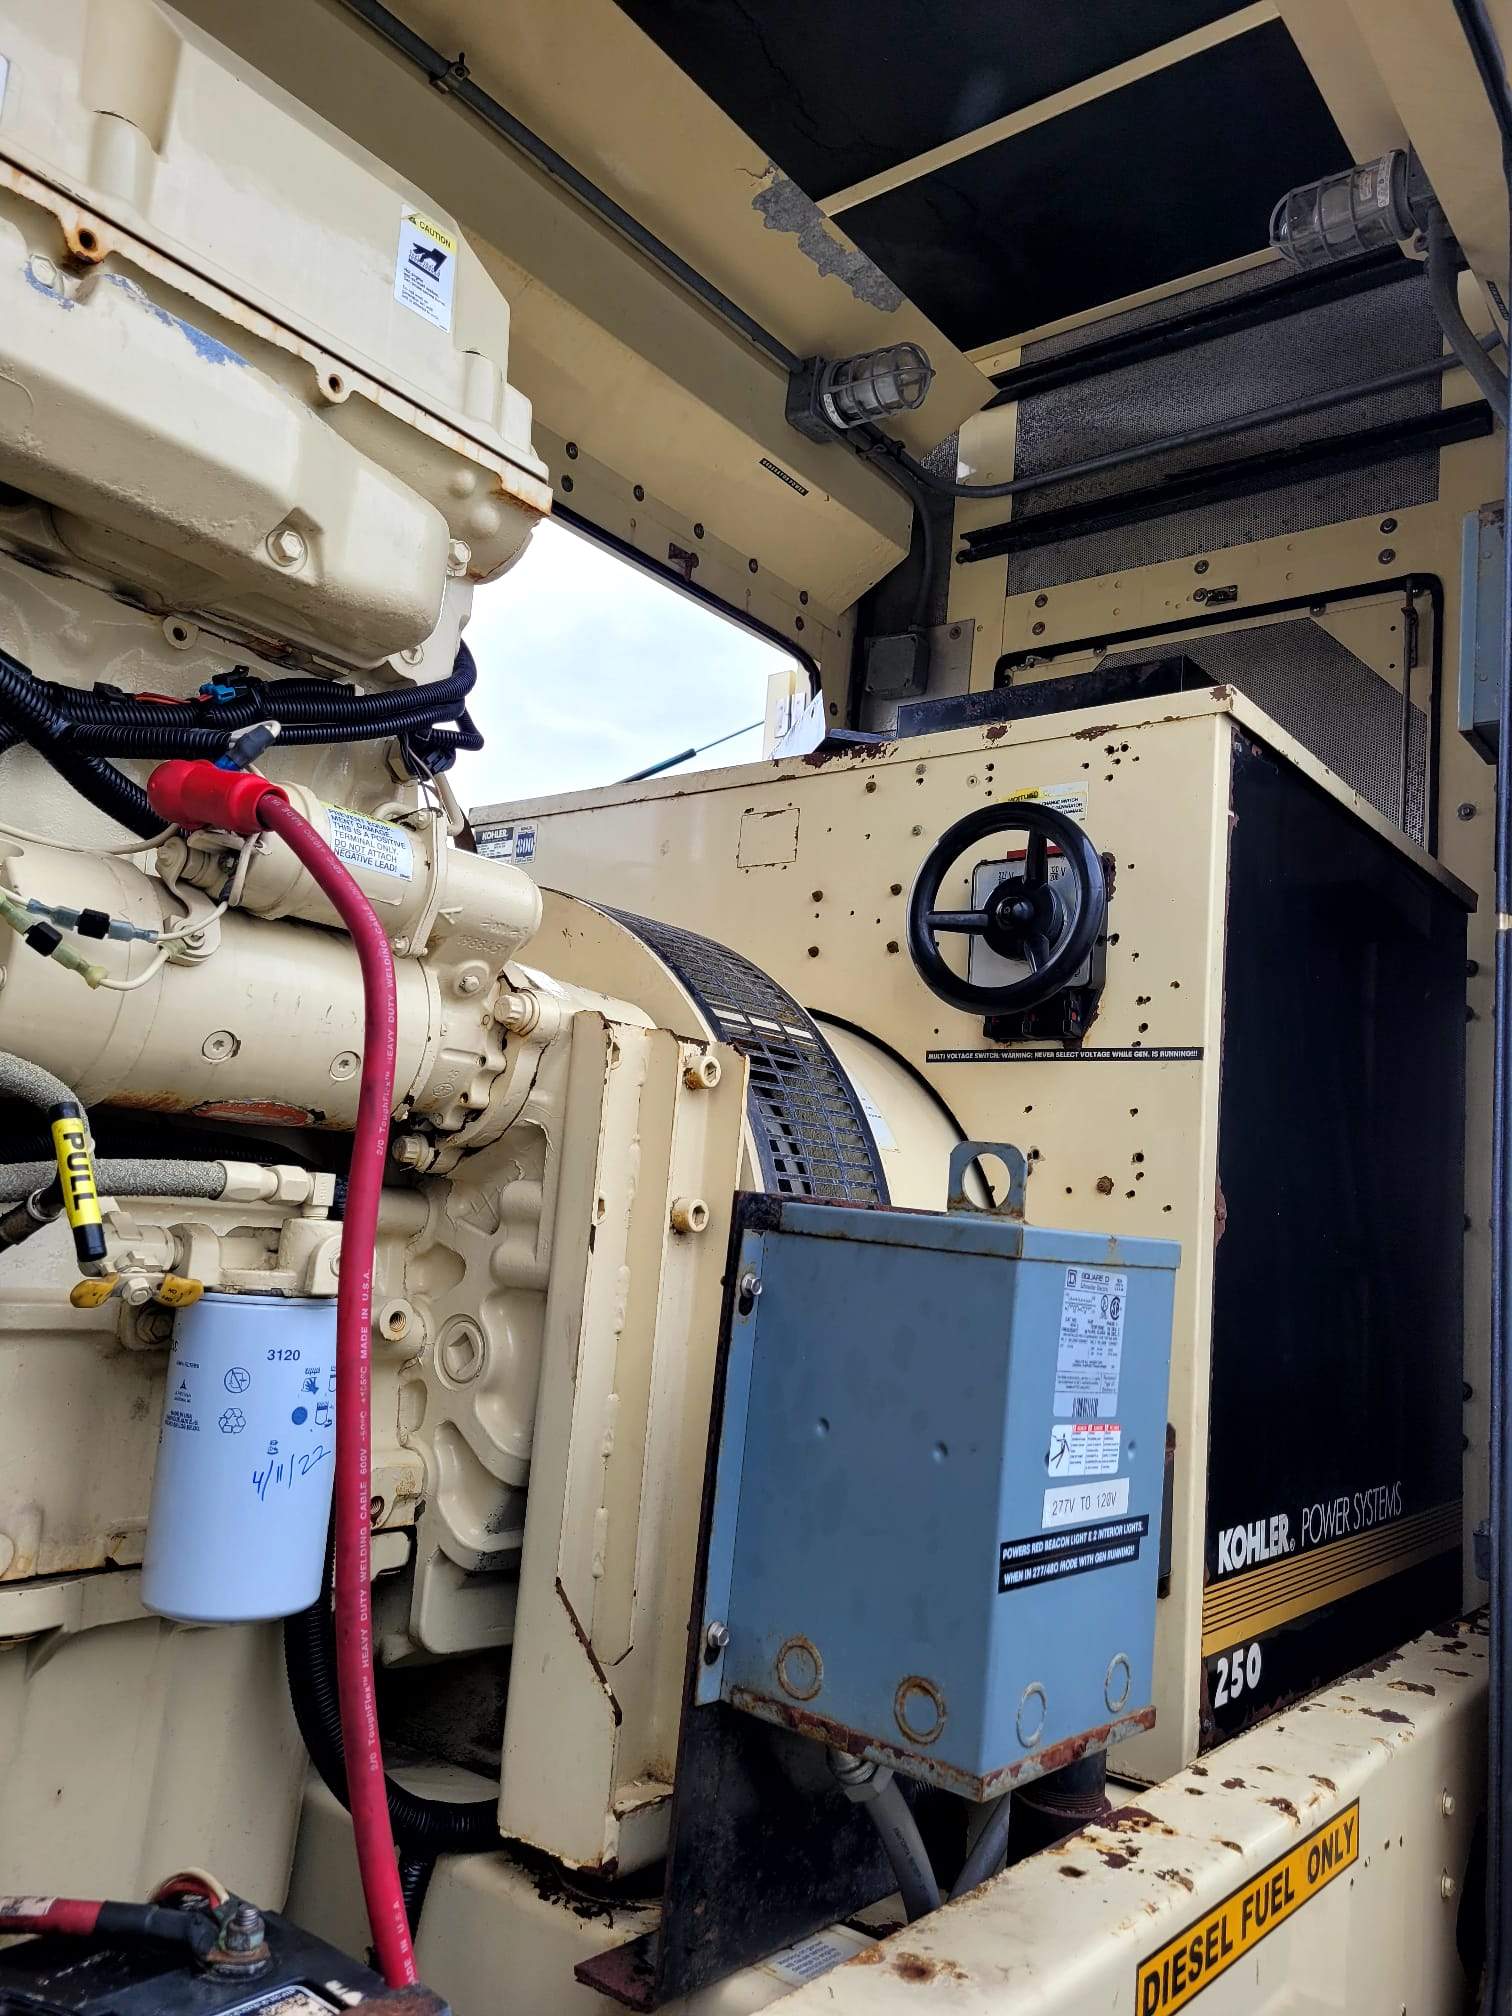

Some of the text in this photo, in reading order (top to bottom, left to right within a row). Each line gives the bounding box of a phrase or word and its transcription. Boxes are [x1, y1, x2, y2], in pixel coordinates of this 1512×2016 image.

[420, 221, 451, 249] CAUTION
[333, 822, 352, 832] THIS
[353, 828, 362, 836] IS
[370, 834, 406, 850] POSITIVE
[334, 830, 374, 848] TERMINAL
[482, 828, 508, 840] KOHLER
[334, 838, 396, 863] DO NOT ATTACH
[334, 848, 373, 866] NEGATIVE
[1060, 866, 1066, 876] V
[362, 904, 382, 935] CABLE
[380, 940, 394, 988] WELDING
[386, 1028, 394, 1064] HEAVY
[946, 1052, 974, 1060] VOLTAGE
[1080, 1050, 1110, 1058] VOLTAGE
[1112, 1050, 1132, 1058] WHILE
[1134, 1050, 1150, 1058] GEN.
[1152, 1050, 1158, 1058] IS
[63, 1132, 97, 1212] PULL
[362, 1308, 368, 1320] IN
[266, 1349, 300, 1361] 3120
[360, 1327, 368, 1359] MADE
[252, 1445, 332, 1502] 4/11/22
[360, 1449, 368, 1474] 600V
[360, 1482, 368, 1520] CABLE
[1052, 1491, 1117, 1516] 277V TO 120V
[1302, 1496, 1350, 1547] POWER
[1353, 1480, 1402, 1530] SYSTEMS
[360, 1526, 368, 1583] WELDING
[1002, 1544, 1030, 1560] POWERS
[1032, 1542, 1044, 1554] RED
[1044, 1536, 1070, 1552] BEACON
[1070, 1532, 1088, 1545] LIGHT
[1093, 1531, 1098, 1542] 2
[1098, 1524, 1124, 1540] INTERIOR
[1124, 1521, 1144, 1534] LIGHTS.
[1004, 1570, 1023, 1585] WHEN
[1024, 1569, 1032, 1580] IN
[1032, 1564, 1059, 1578] 277/480
[1060, 1558, 1078, 1571] MODE
[1078, 1554, 1094, 1568] WITH
[1094, 1552, 1108, 1564] GEN
[360, 1590, 368, 1620] DUTY
[360, 1630, 370, 1668] HEAVY
[1214, 1642, 1262, 1709] 250
[1143, 1816, 1355, 2016] DIESEL FUEL ONLY
[400, 1938, 408, 1954] IN
